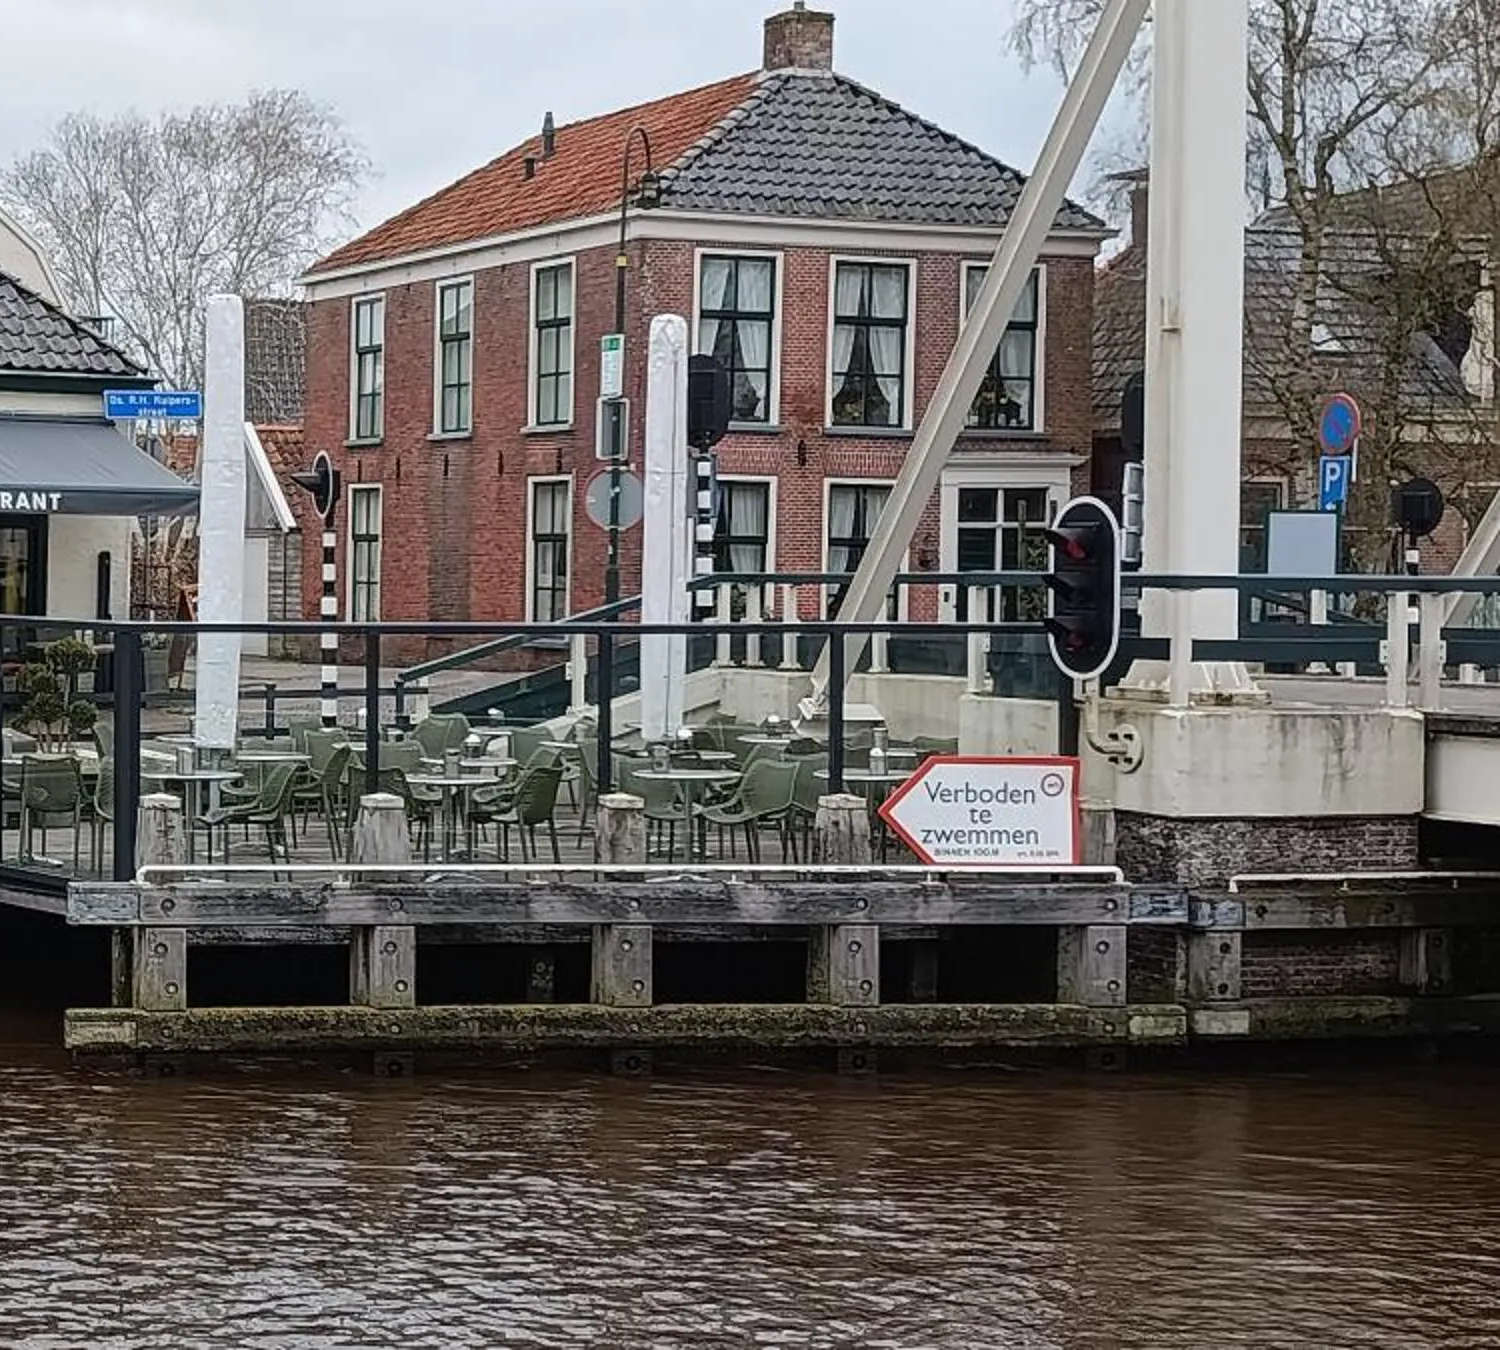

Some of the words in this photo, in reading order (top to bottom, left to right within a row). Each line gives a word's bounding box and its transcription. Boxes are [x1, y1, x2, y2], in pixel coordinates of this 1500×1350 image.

[109, 395, 124, 405] Ds.
[128, 395, 150, 405] R.H.
[138, 407, 167, 416] straat
[1324, 461, 1341, 493] P
[924, 781, 1036, 804] Verboden
[969, 808, 992, 824] te
[920, 829, 1039, 845] zwemmen
